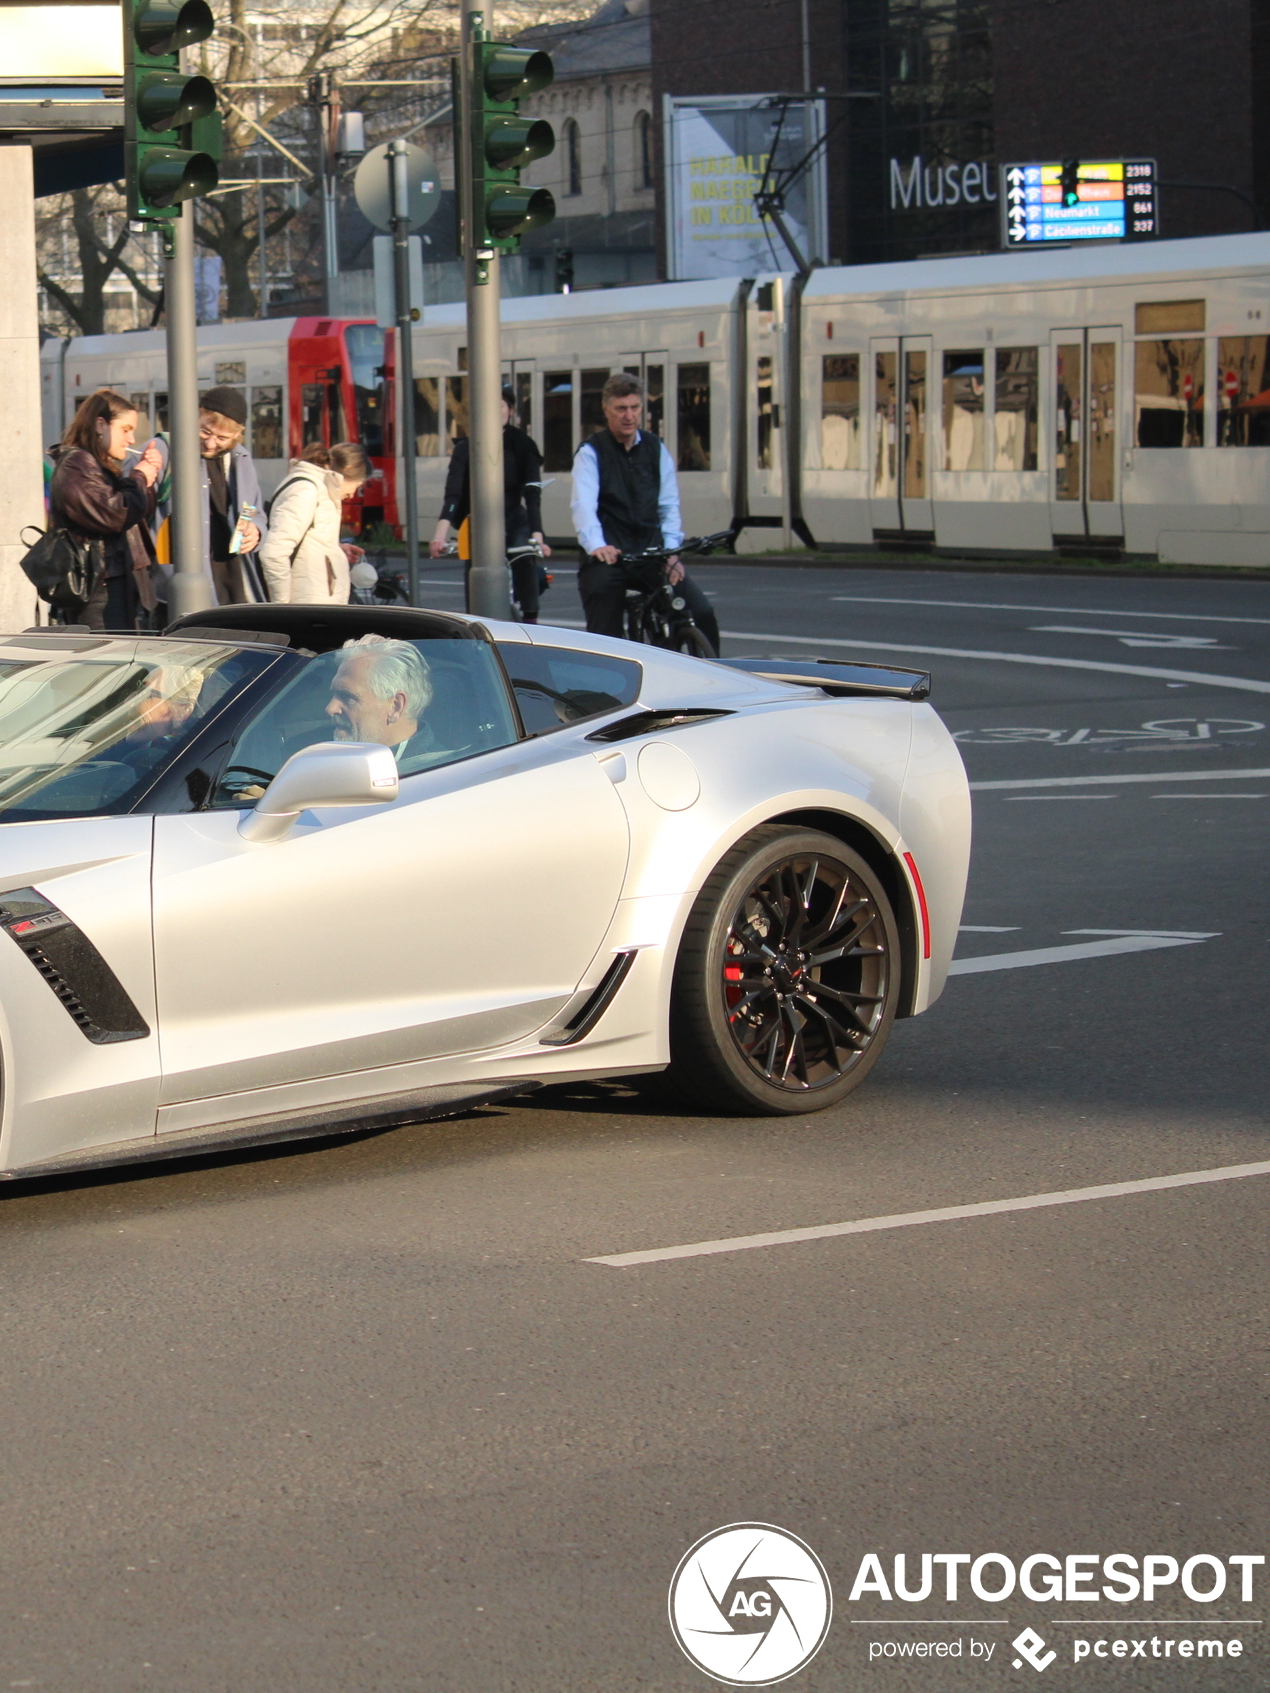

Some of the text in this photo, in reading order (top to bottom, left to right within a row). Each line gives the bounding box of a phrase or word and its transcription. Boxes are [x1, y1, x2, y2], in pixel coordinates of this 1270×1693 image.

[1126, 164, 1151, 178] 2318
[1126, 183, 1152, 196] 2152
[691, 206, 711, 226] IN
[1045, 206, 1100, 218] Neumarkt
[1133, 202, 1152, 213] 861
[1133, 220, 1153, 232] 337
